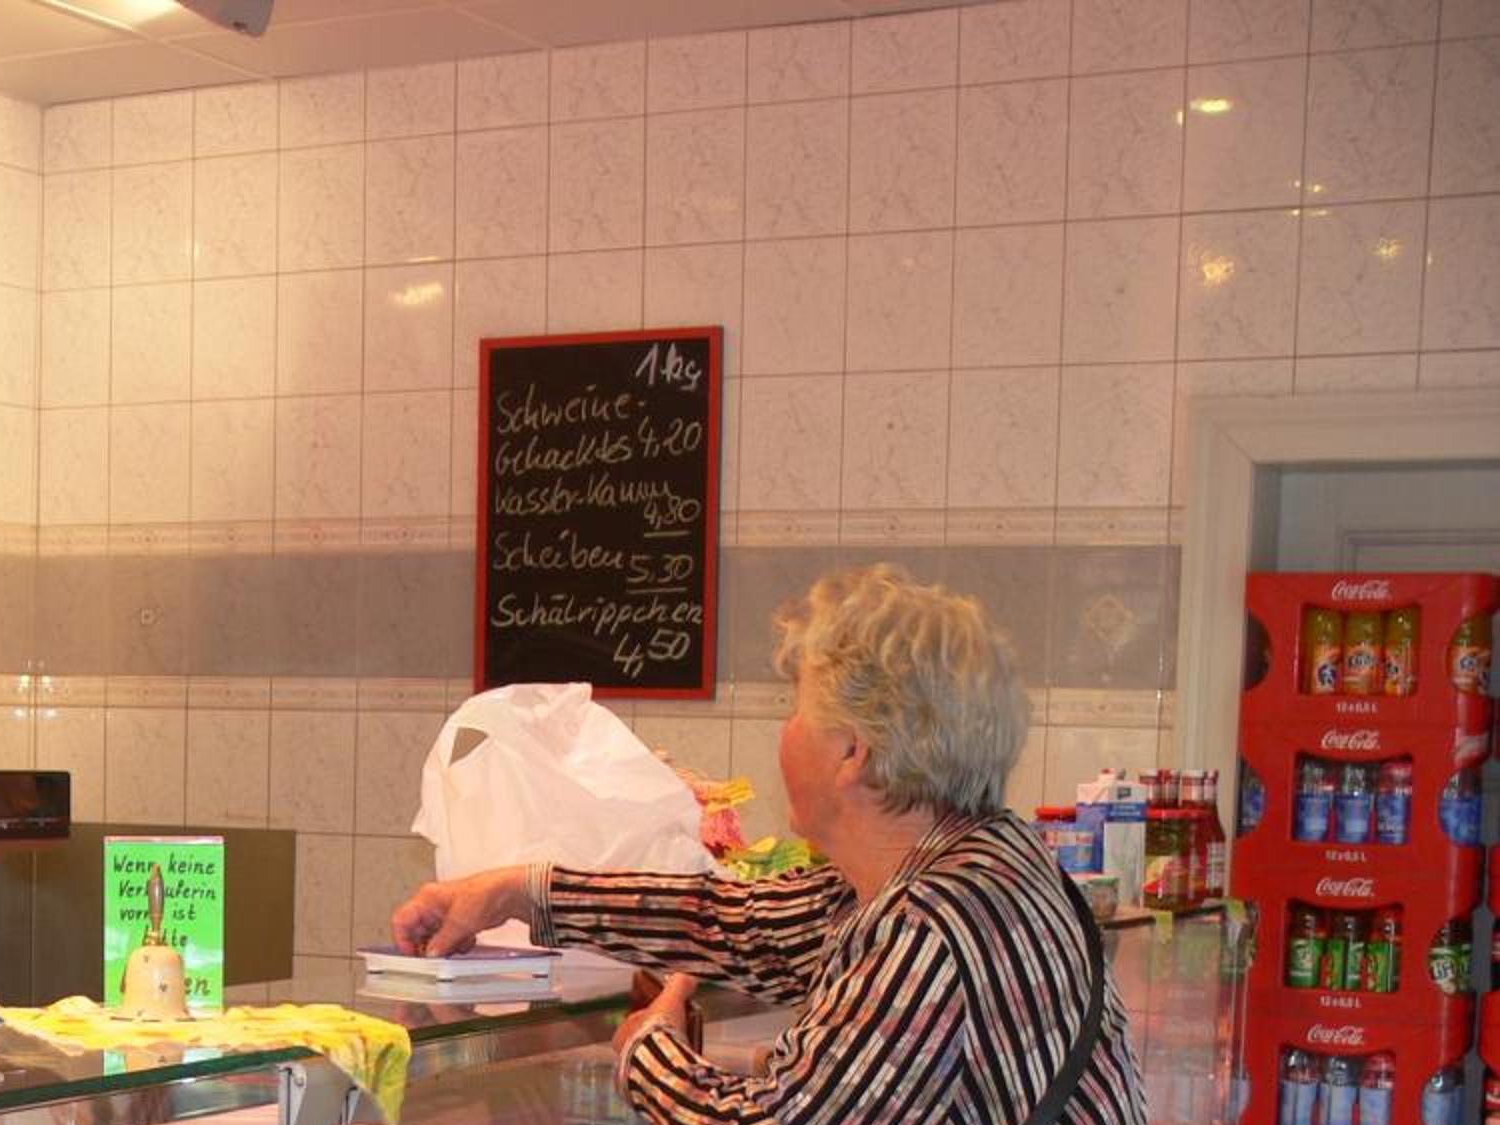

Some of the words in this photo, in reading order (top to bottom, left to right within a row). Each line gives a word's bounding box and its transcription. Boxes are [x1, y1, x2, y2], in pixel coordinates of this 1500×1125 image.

[637, 416, 702, 459] 4,20
[492, 529, 624, 570] Scheiben
[491, 592, 704, 635] Schälrippchen
[613, 629, 693, 679] 4,50
[167, 852, 216, 875] keine
[172, 902, 197, 921] ist
